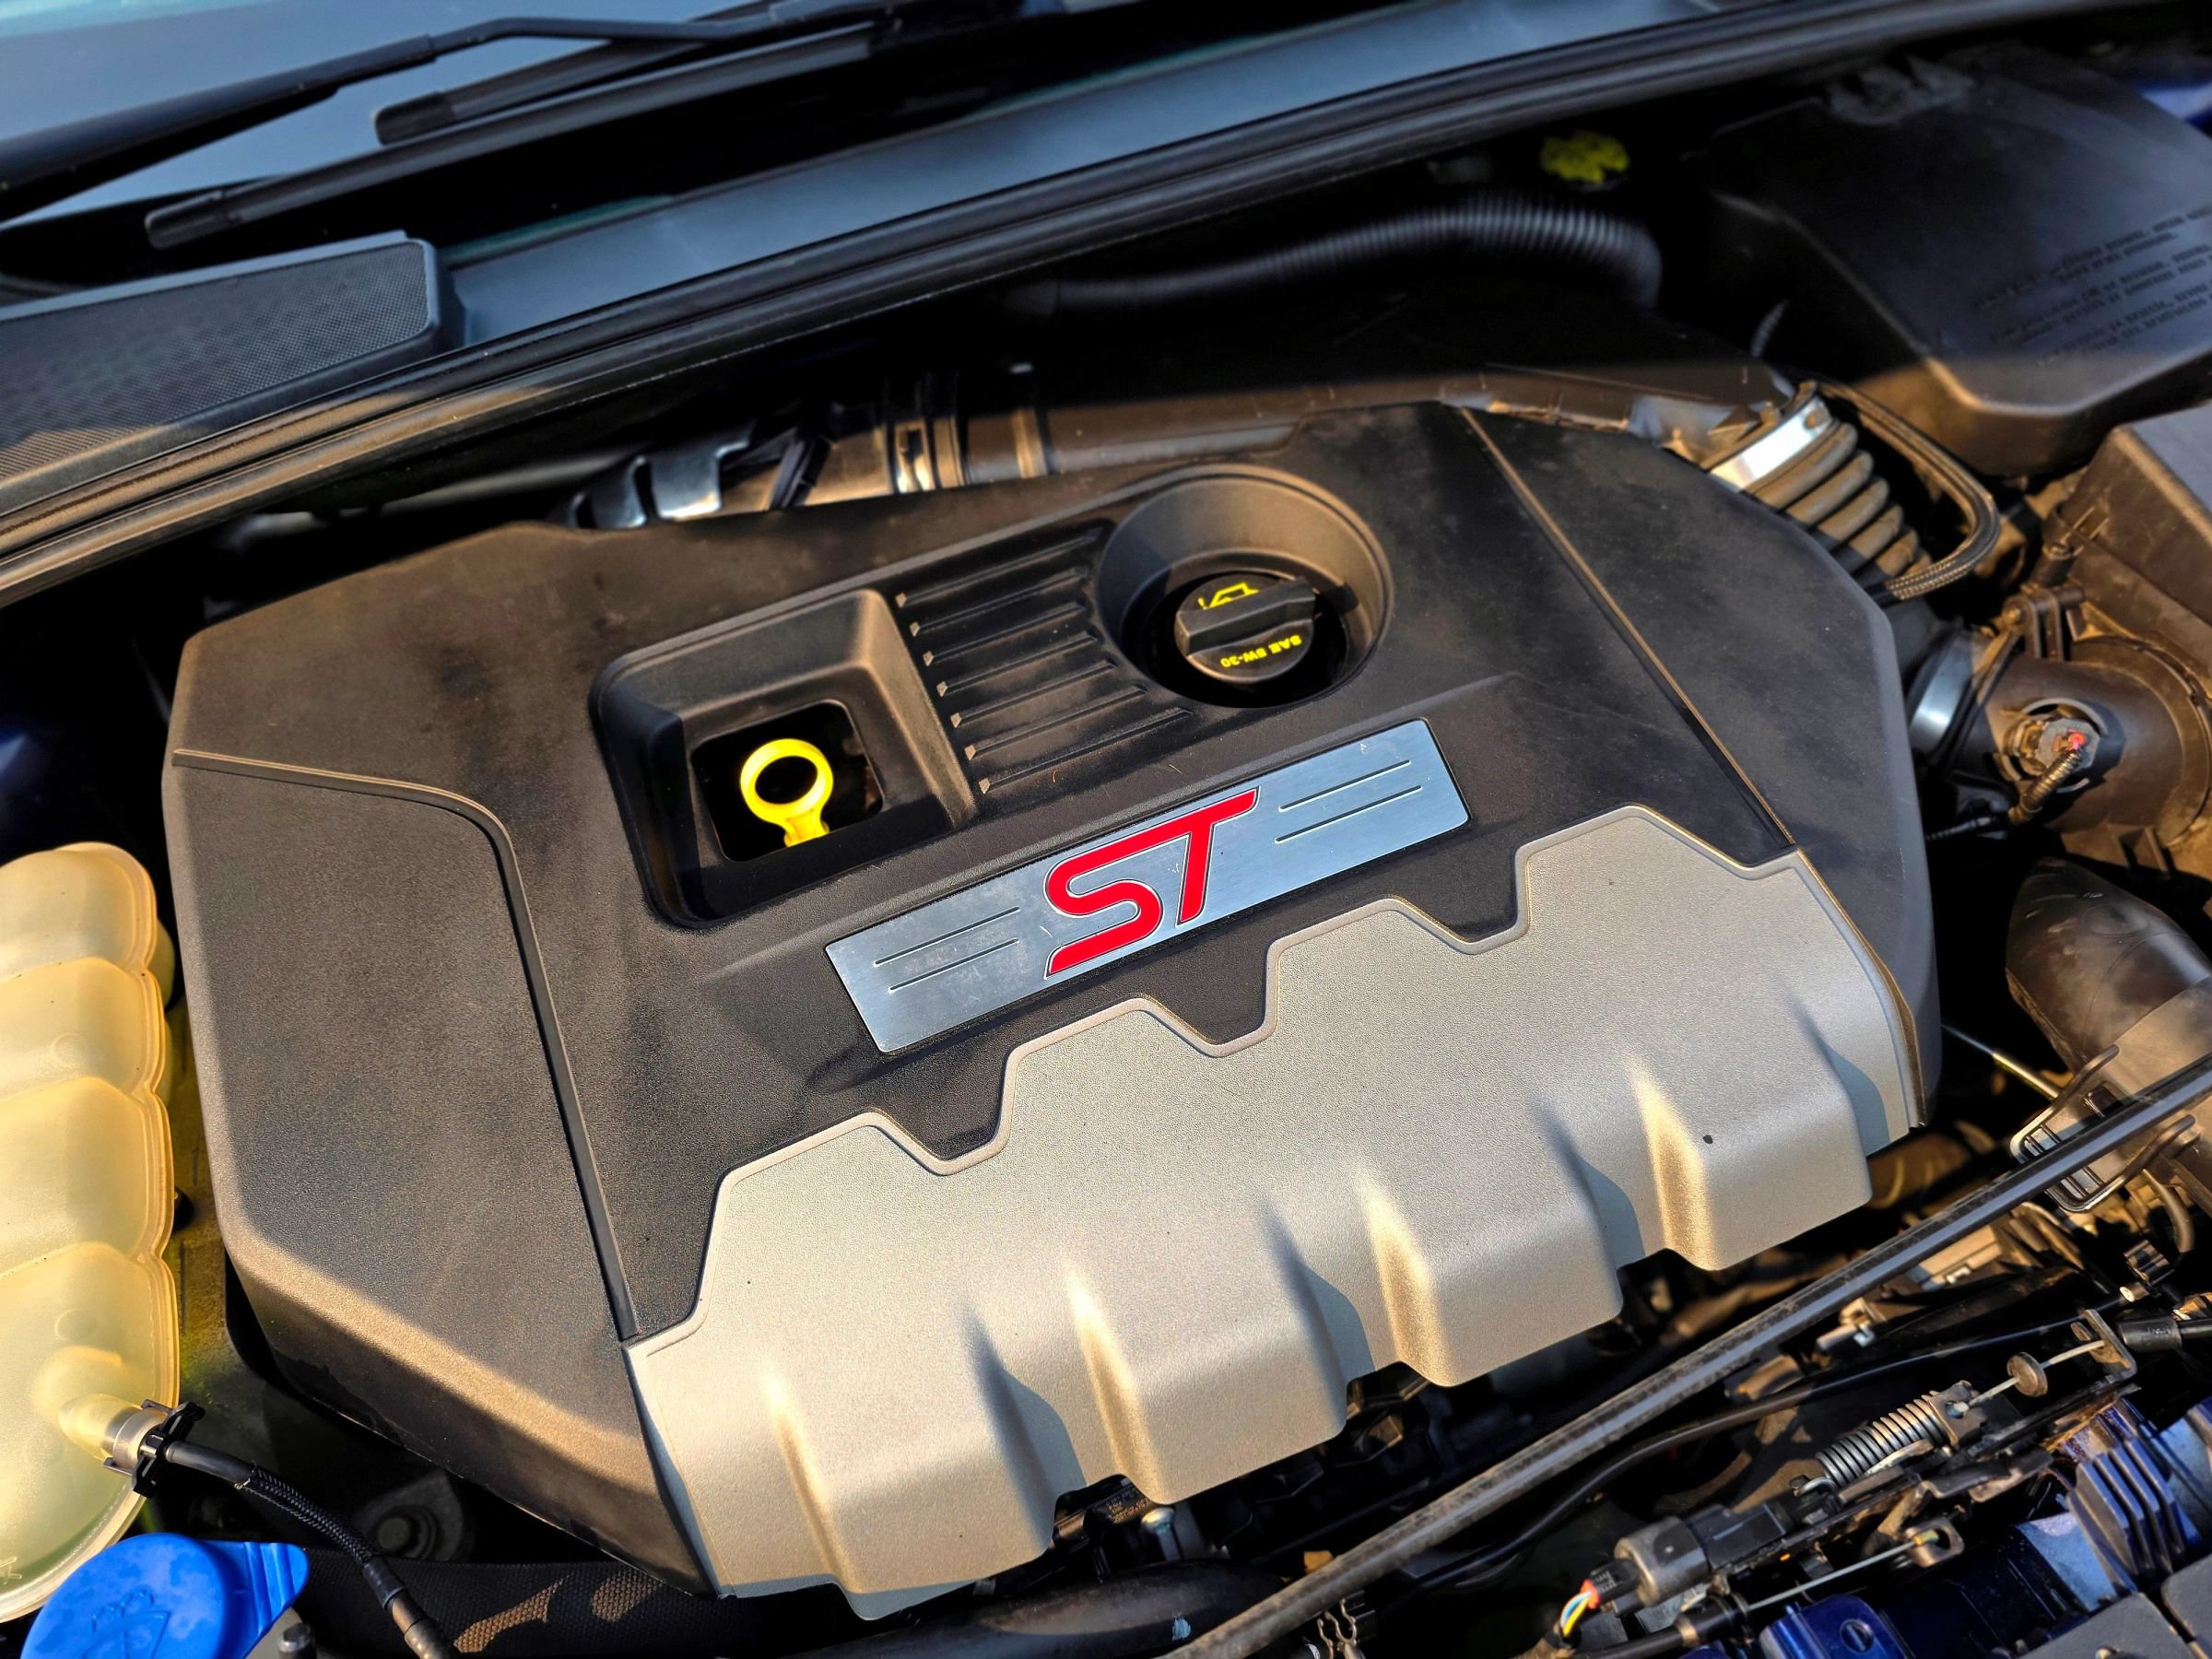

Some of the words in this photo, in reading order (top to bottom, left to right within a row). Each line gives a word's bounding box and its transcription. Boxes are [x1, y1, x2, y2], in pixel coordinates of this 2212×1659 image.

[1268, 635, 1301, 653] SAE
[1220, 648, 1267, 667] 5W-30
[1046, 787, 1259, 977] ST
